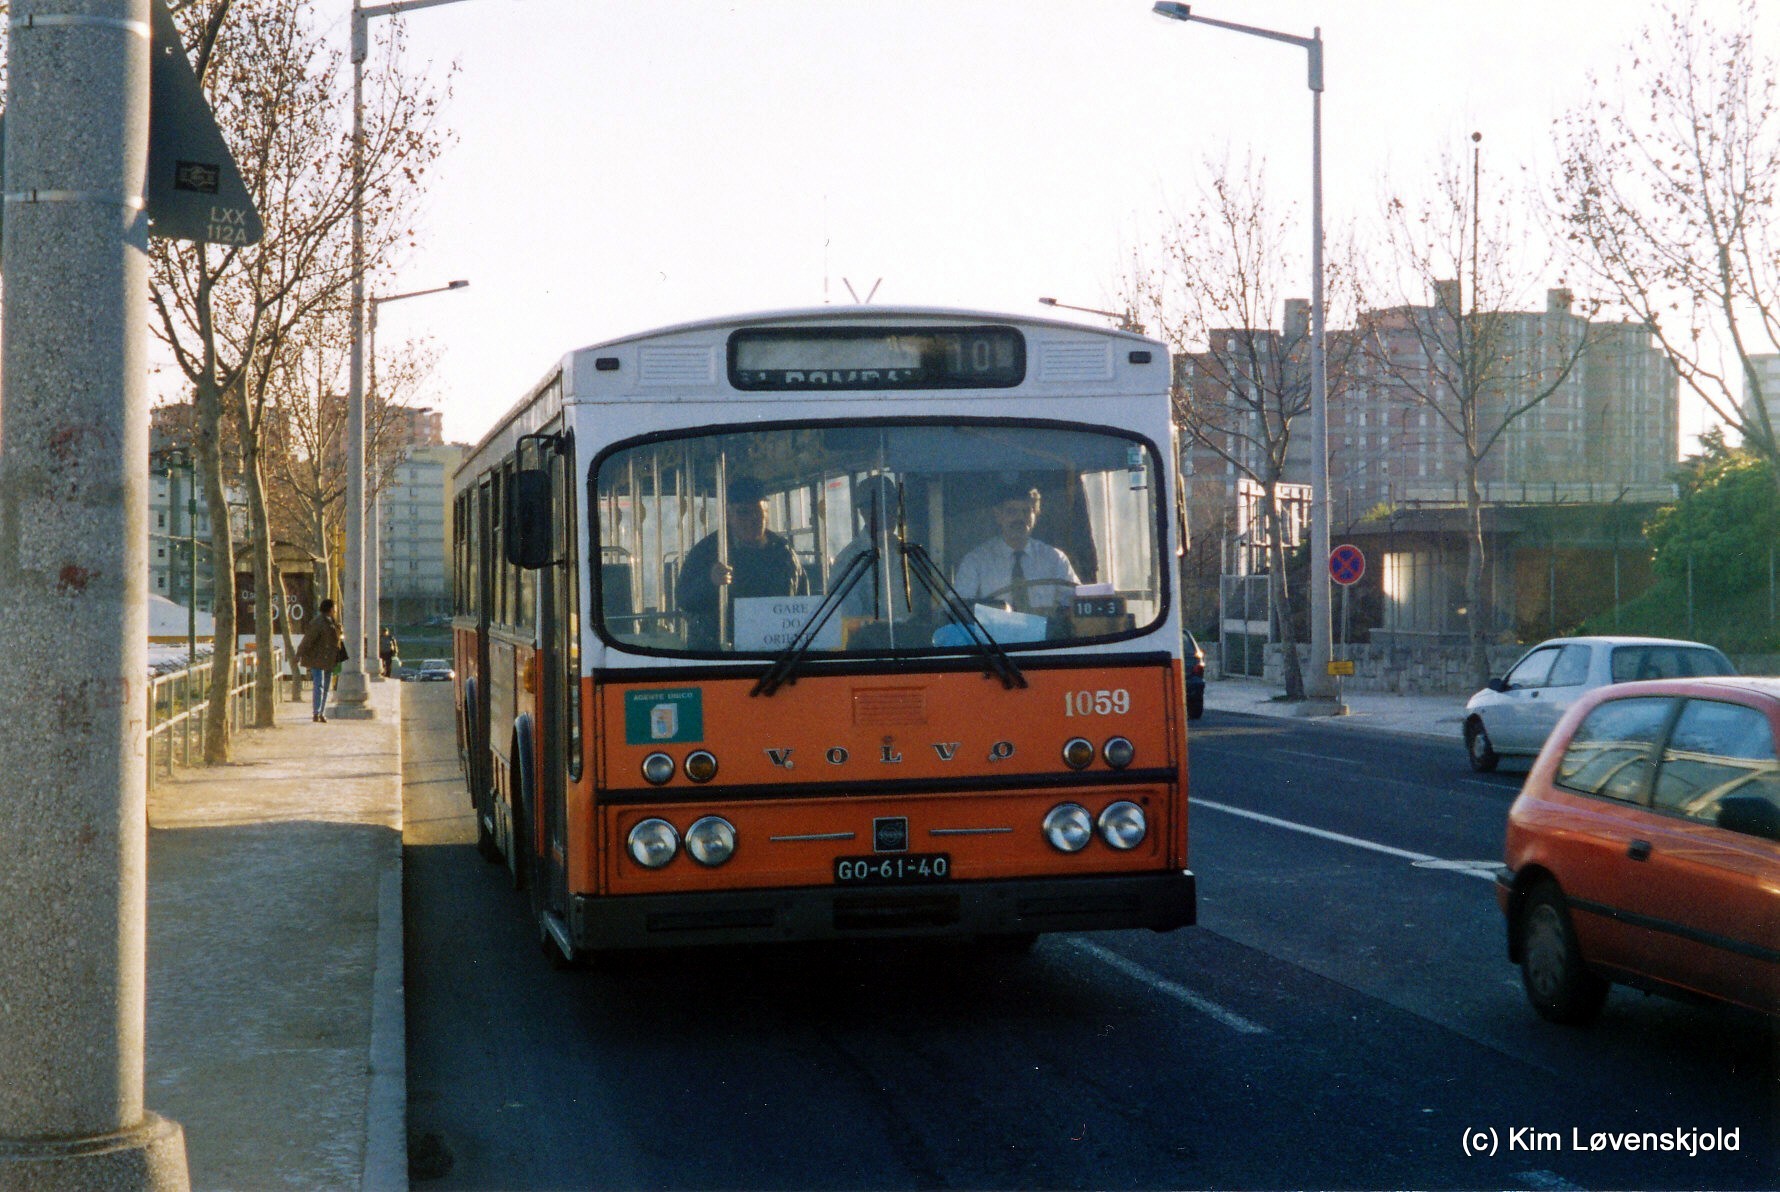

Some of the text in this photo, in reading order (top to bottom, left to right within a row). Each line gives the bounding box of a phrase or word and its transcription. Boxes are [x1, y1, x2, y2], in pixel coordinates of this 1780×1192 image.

[211, 206, 246, 225] LXX
[207, 224, 247, 243] 112A
[772, 603, 808, 614] GARE
[782, 619, 801, 628] DO
[1065, 688, 1130, 717] 1059
[763, 741, 1015, 766] VOLVO
[838, 857, 947, 880] GO-61-40
